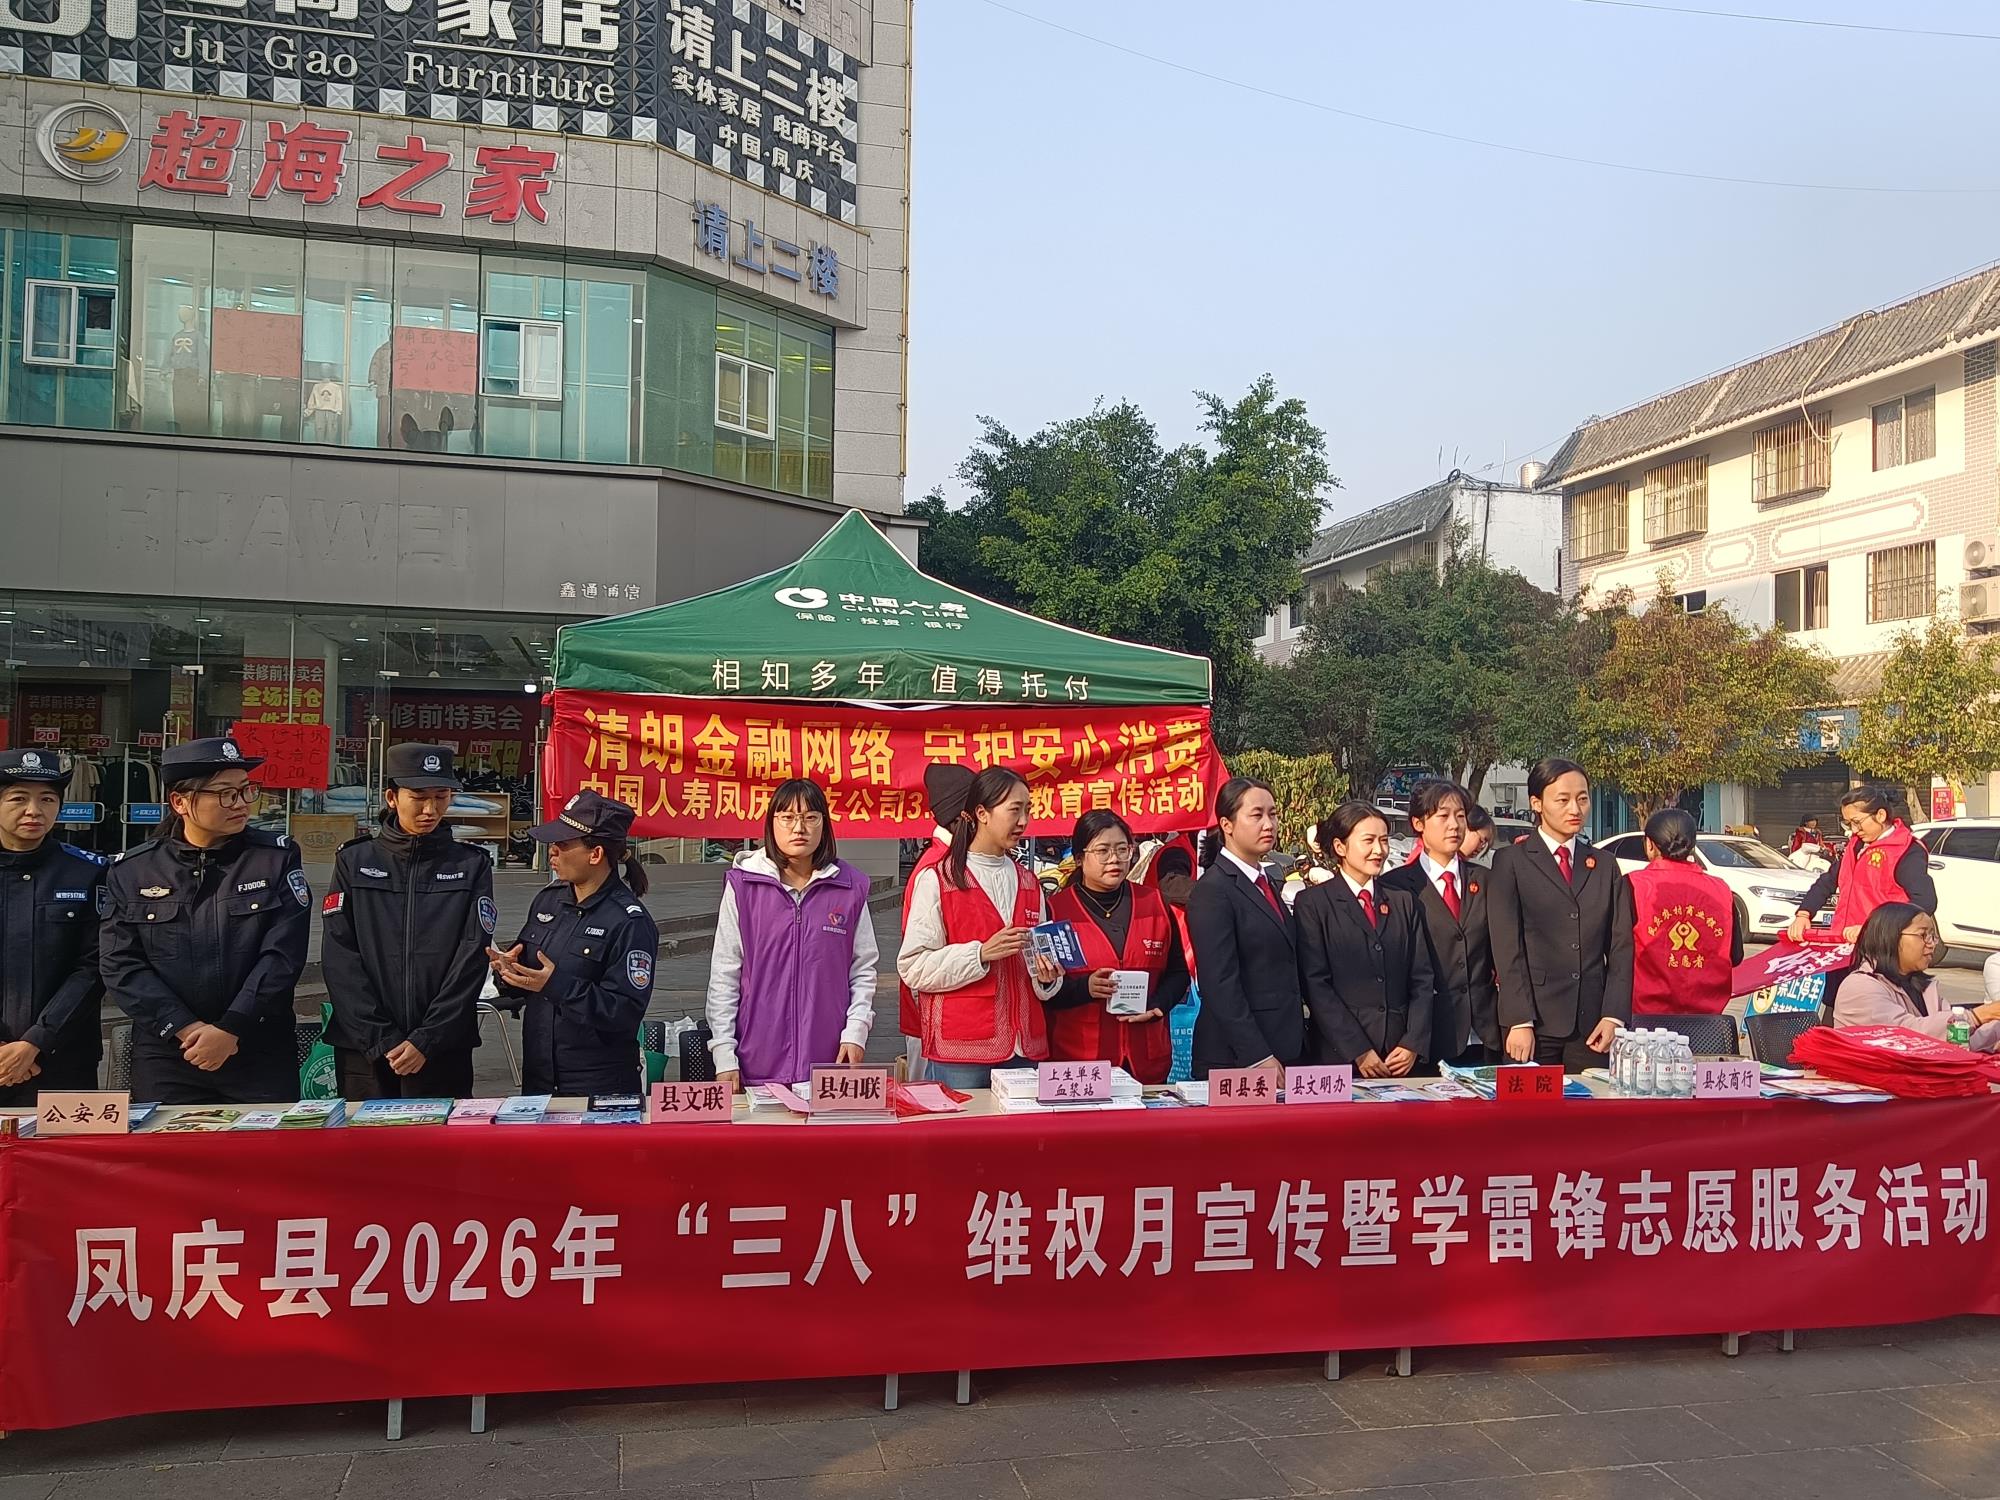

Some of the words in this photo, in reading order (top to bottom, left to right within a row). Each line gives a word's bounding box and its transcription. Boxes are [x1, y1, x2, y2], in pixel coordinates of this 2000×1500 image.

[172, 26, 225, 64] Ju
[263, 35, 359, 78] Gao
[403, 50, 615, 106] Furniture
[665, 0, 847, 138] 请上三楼
[672, 65, 762, 127] 实体家居
[773, 114, 846, 165] 电商平台
[138, 110, 562, 225] 超海之家
[691, 200, 839, 299] 请上二楼
[838, 593, 967, 614] 中国人寿
[841, 604, 915, 616] CHINA
[921, 611, 971, 620] LIFE
[243, 664, 323, 681] 装修前特卖会
[711, 659, 886, 691] 相知多年
[931, 664, 1089, 700] 值得托付
[242, 686, 323, 708] 全场清仓
[583, 707, 895, 785] 清朗金融网络
[923, 720, 1202, 780] 守护安心消费
[1048, 1064, 1103, 1082] 上生单采
[1702, 1069, 1754, 1089] 县农商行
[817, 1076, 880, 1100] 县妇联
[1054, 1083, 1095, 1098] 血浆站
[1219, 1078, 1269, 1098] 团县委
[1292, 1075, 1347, 1096] 县文明办
[1508, 1075, 1553, 1094] 法院
[660, 1085, 724, 1113] 县文联
[42, 1102, 120, 1125] 公安局
